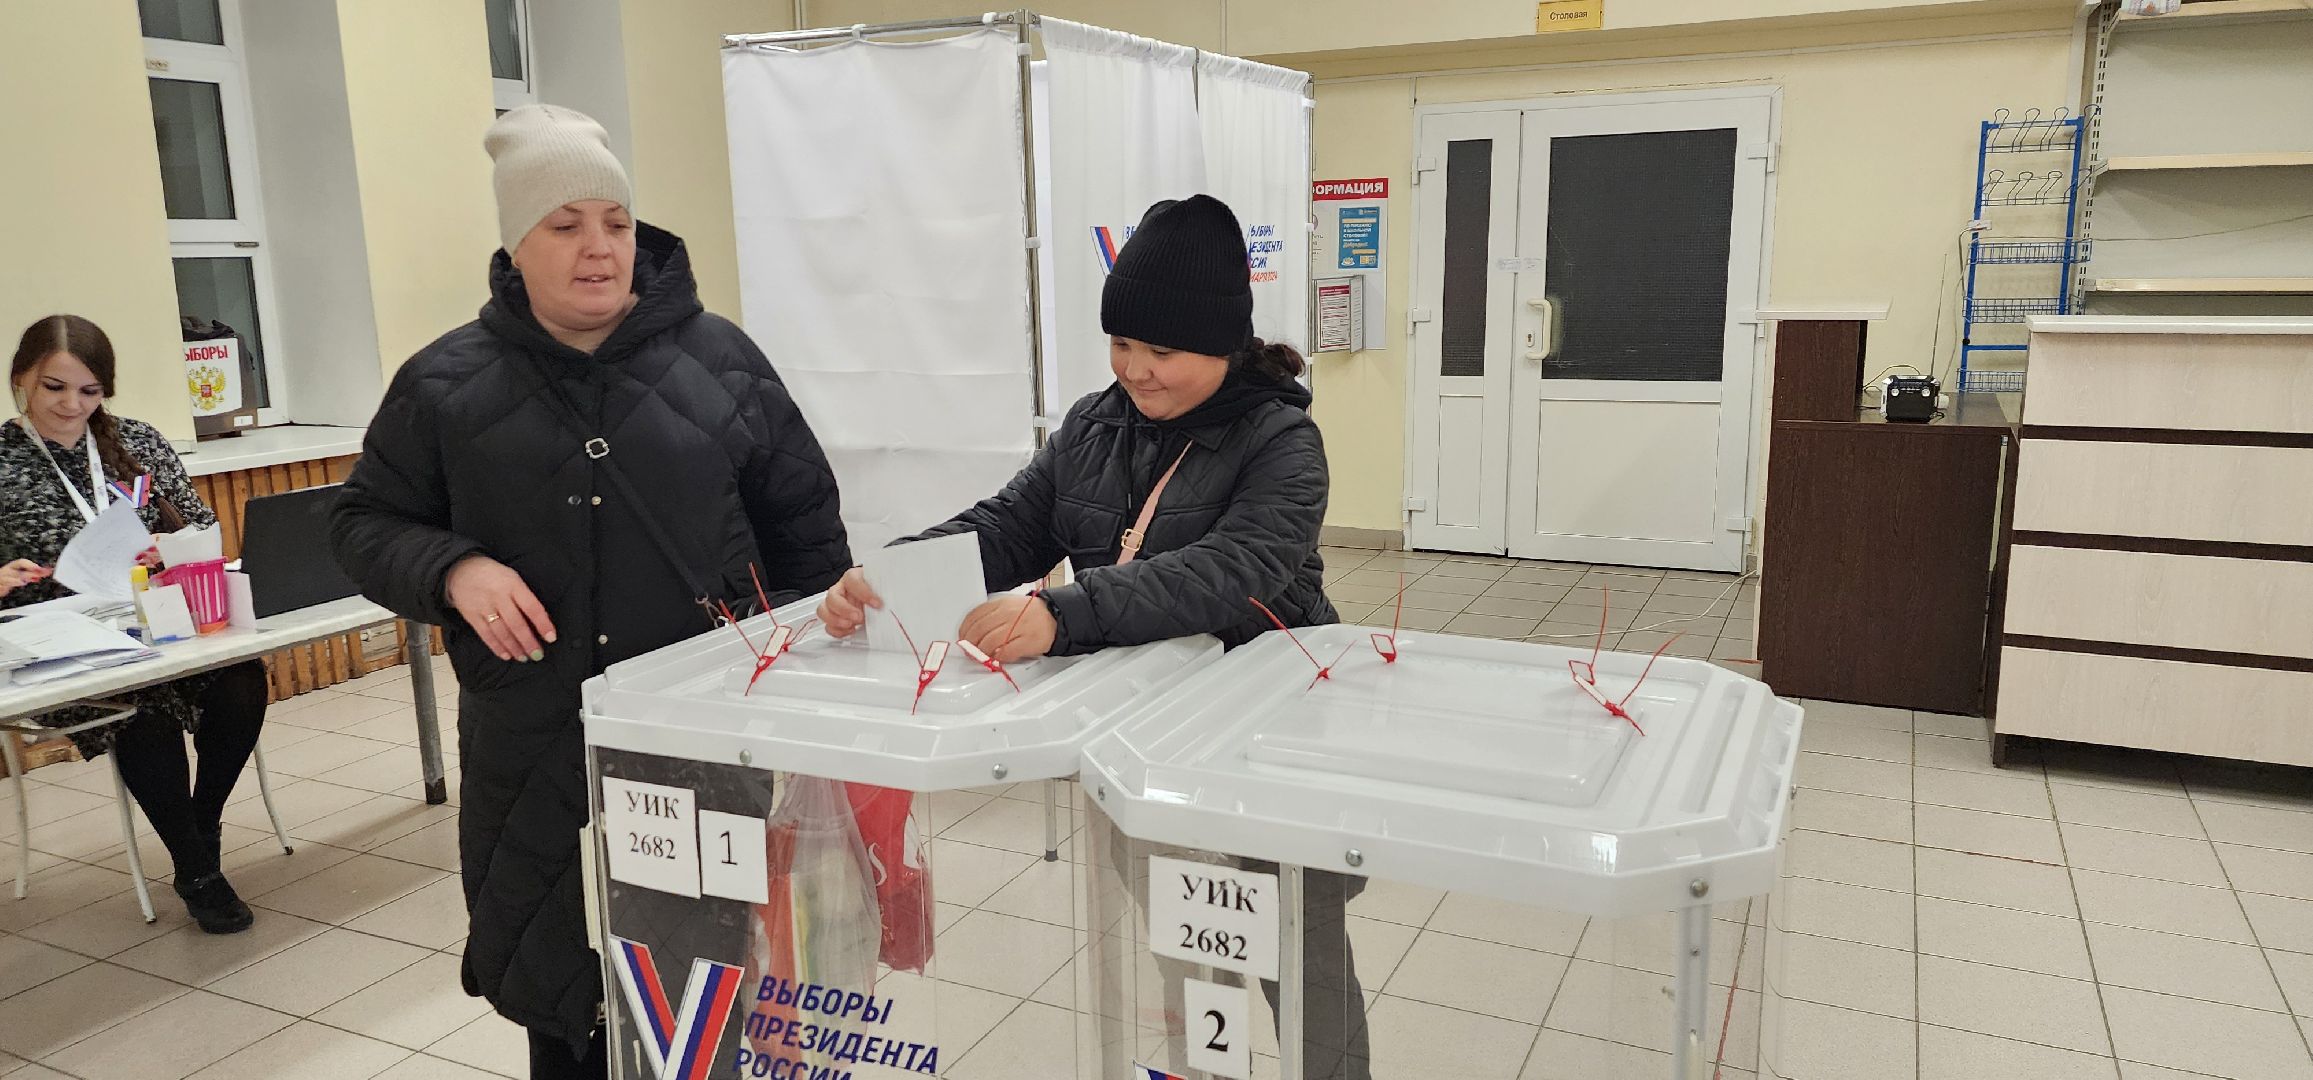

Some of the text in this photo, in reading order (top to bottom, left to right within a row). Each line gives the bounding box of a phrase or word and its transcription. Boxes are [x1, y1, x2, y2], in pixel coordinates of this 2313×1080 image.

[1549, 11, 1588, 20] Столовая
[624, 789, 679, 820] УИК
[628, 832, 677, 860] 2682
[719, 831, 738, 866] 1
[1180, 873, 1257, 914] УИК
[1179, 923, 1248, 961] 2682
[757, 975, 893, 1025] ВЫБОРЫ
[744, 1011, 939, 1074] ПРЕЗИДЕНТА
[1204, 1010, 1229, 1052] 2
